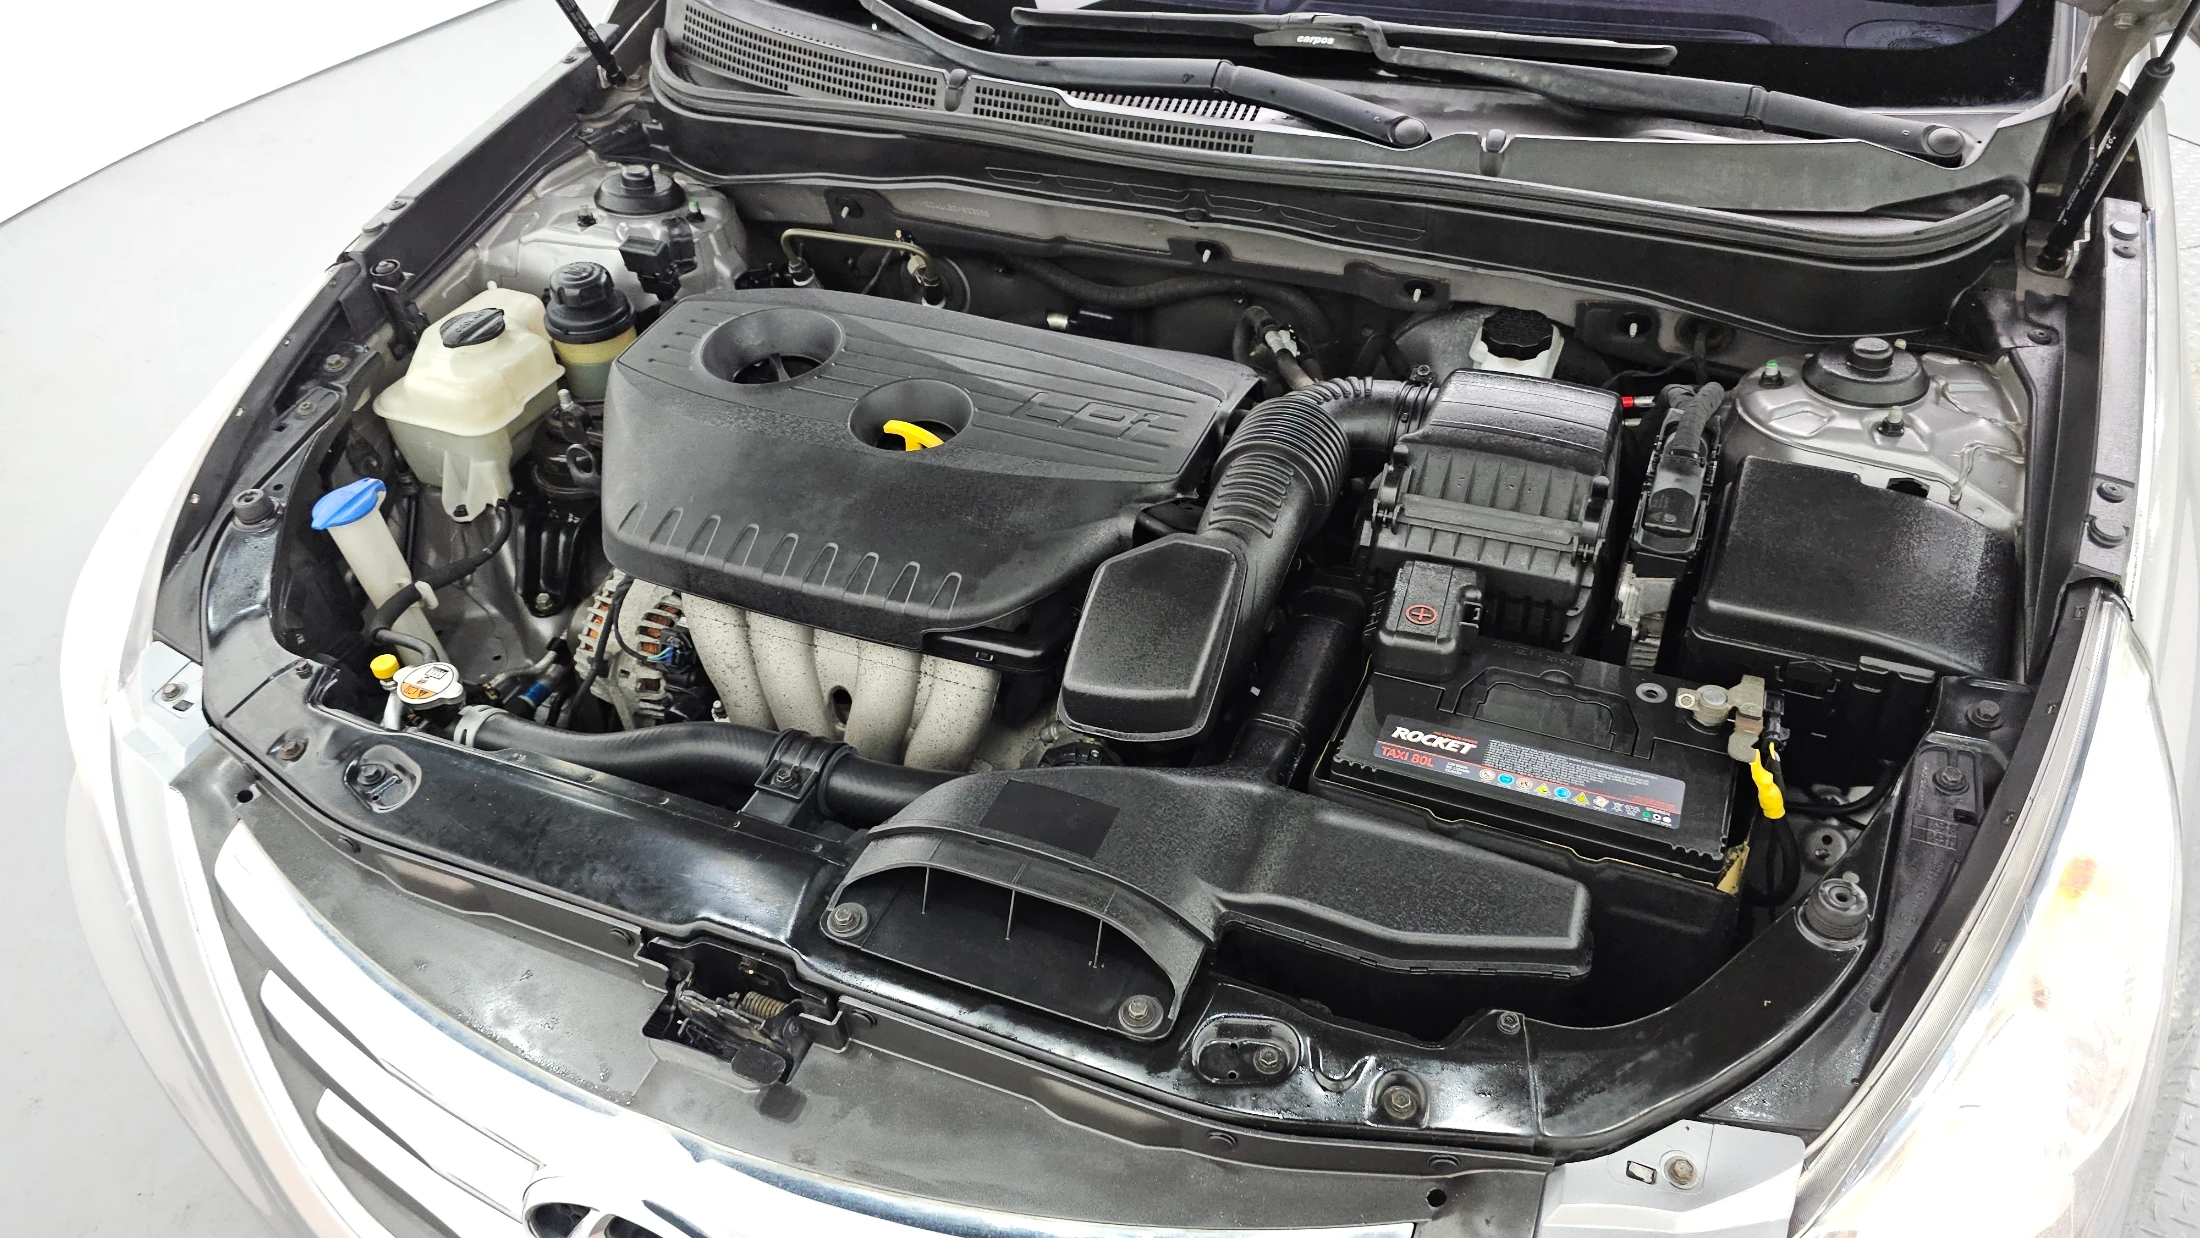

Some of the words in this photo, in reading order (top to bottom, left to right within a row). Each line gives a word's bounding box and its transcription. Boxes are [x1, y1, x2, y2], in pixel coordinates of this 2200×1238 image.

[1296, 35, 1335, 45] carpos
[1391, 726, 1478, 755] ROCKET
[1381, 746, 1409, 761] TAXI
[1411, 753, 1434, 768] 80L
